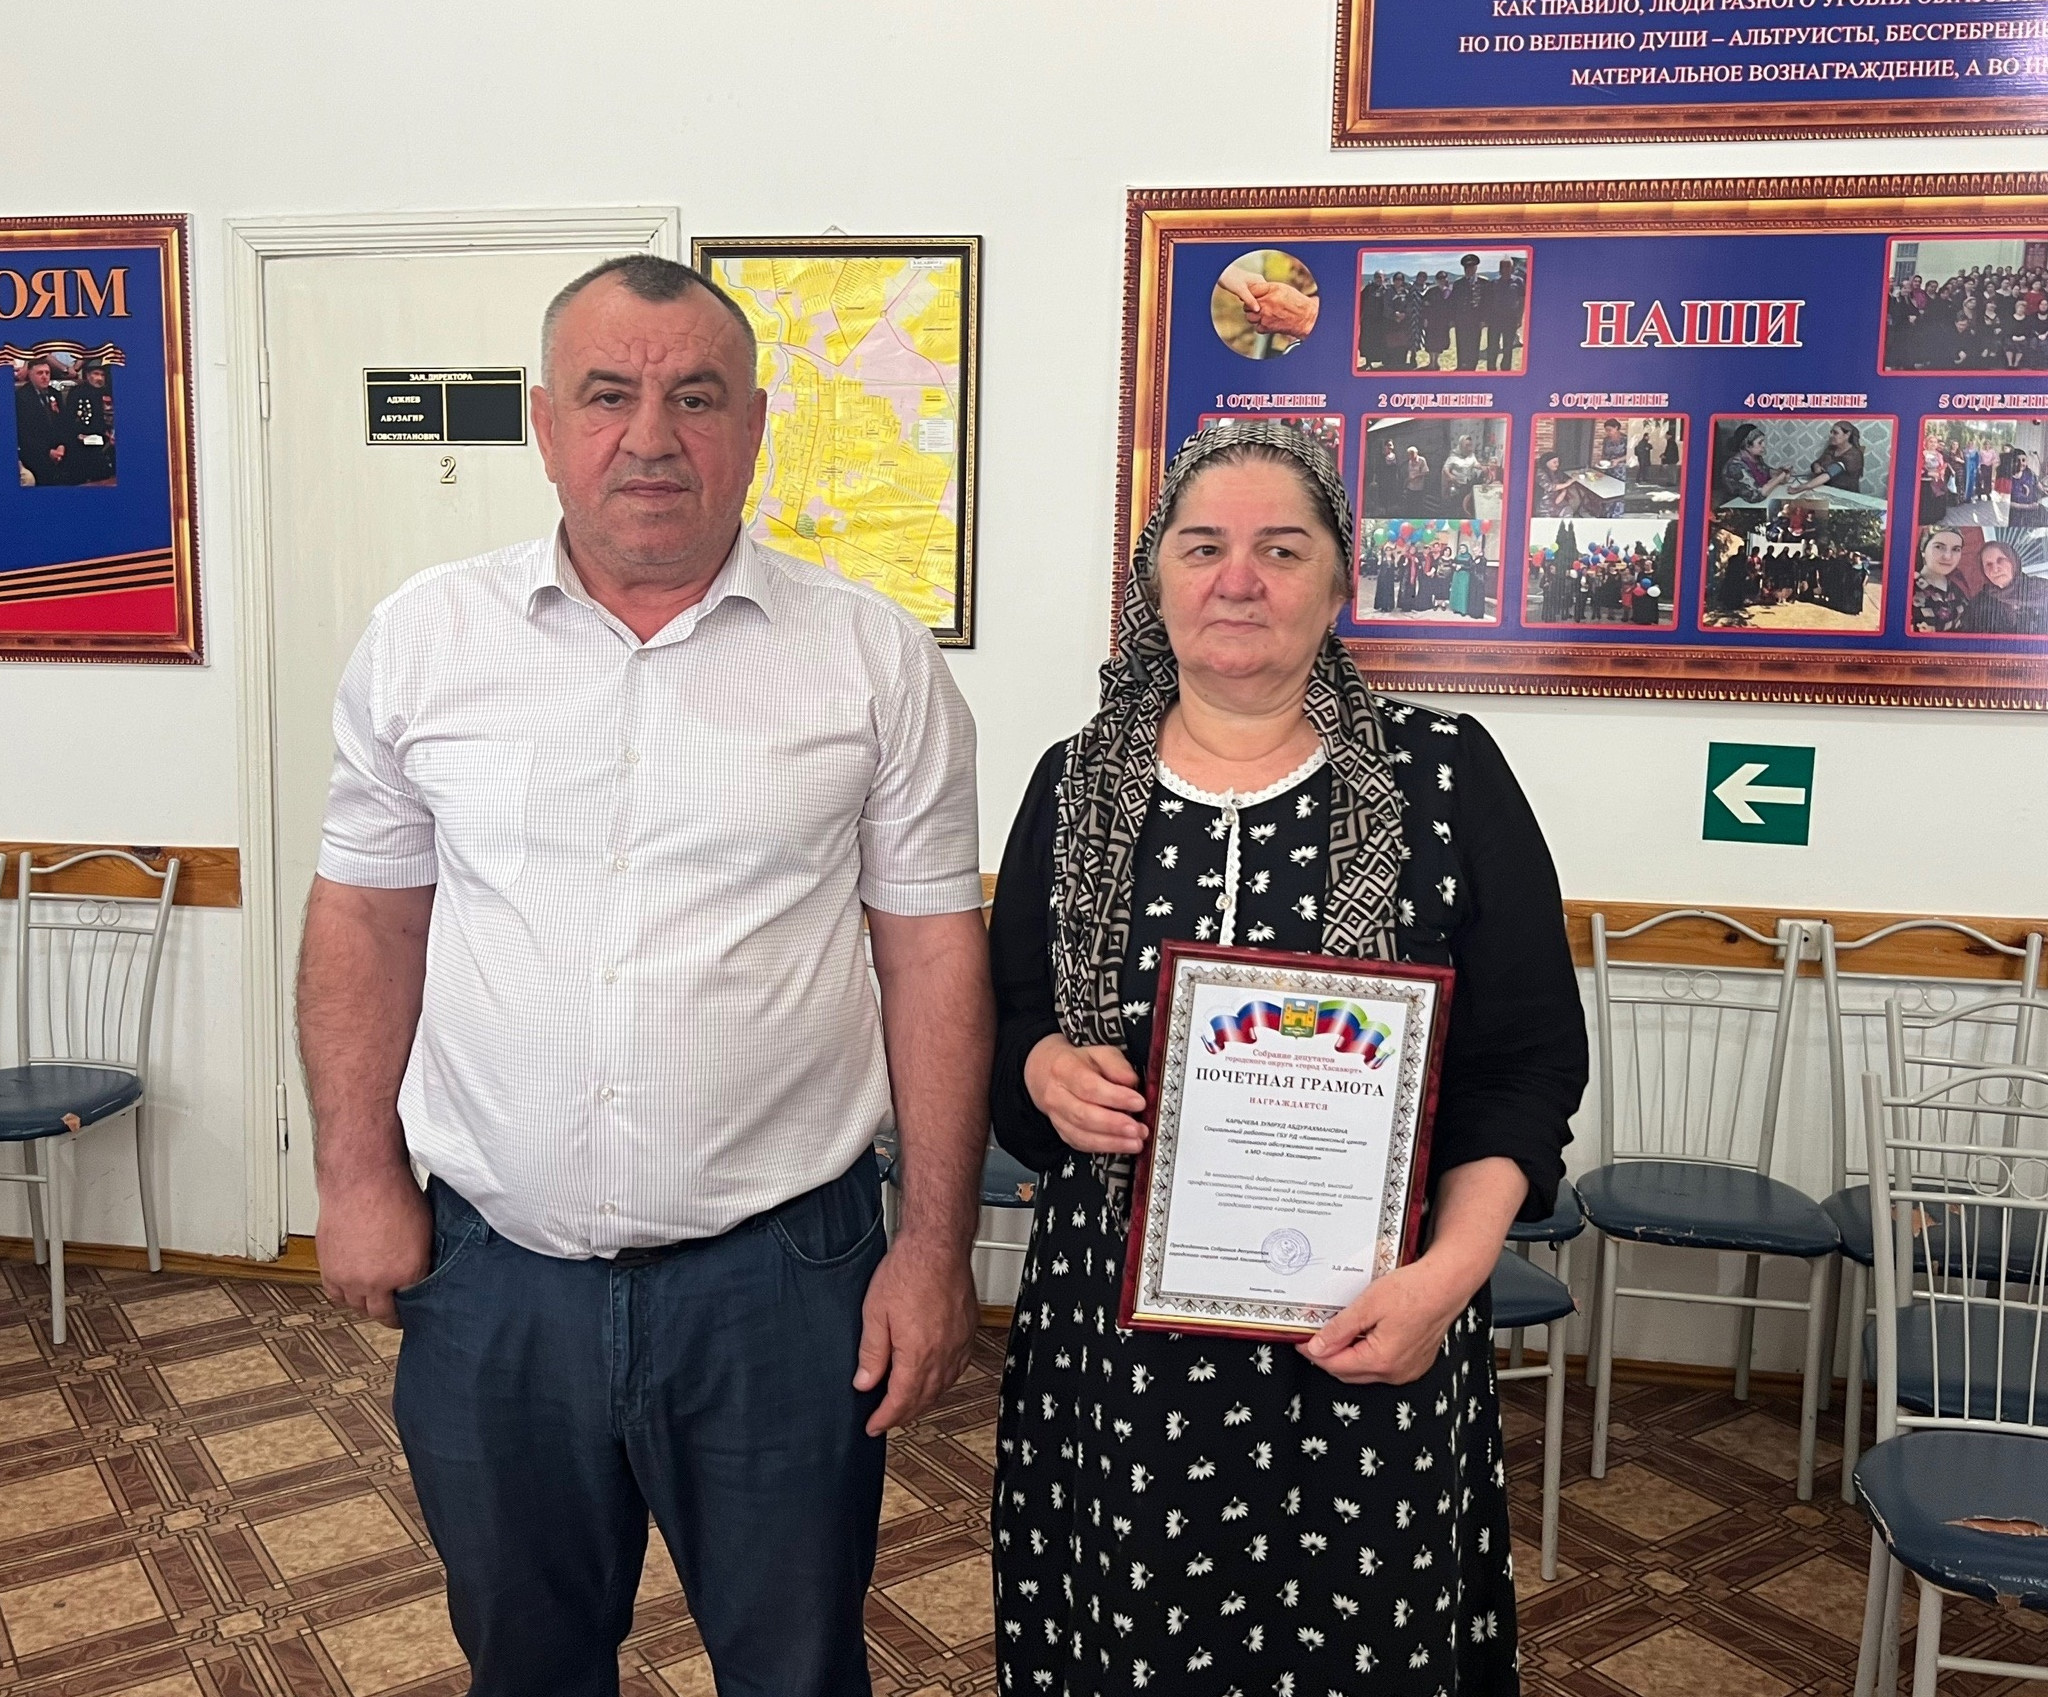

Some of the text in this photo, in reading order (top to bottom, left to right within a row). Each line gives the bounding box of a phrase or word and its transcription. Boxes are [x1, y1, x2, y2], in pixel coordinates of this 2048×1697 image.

[1492, 0, 1535, 17] КАК
[1540, 0, 1644, 16] ПРАВИЛО,
[1649, 0, 1716, 15] ЛЮДИ
[1459, 36, 1489, 52] НО
[1493, 35, 1525, 52] ПО
[1529, 32, 1636, 51] ВЕЛЕНИЮ
[1639, 30, 1709, 52] ДУШИ
[1728, 25, 1880, 47] АЛЬТРУИСТЫ,
[1571, 65, 1743, 86] МАТЕРИАЛЬНОЕ
[1748, 59, 1960, 82] ВОЗНАГРАЖДЕНИЕ,
[1964, 59, 1982, 76] А
[1986, 57, 2020, 76] ВО
[1580, 300, 1806, 348] НАШИ
[1215, 394, 1225, 408] 1
[1378, 394, 1388, 408] 2
[1549, 393, 1559, 407] 3
[1744, 393, 1755, 408] 4
[1938, 393, 1950, 408] 5
[440, 456, 457, 484] 2
[1252, 1048, 1334, 1064] Собрание депутатов
[1195, 1067, 1385, 1097] ПОЧЕТНАЯ ГРАМОТА
[1248, 1097, 1328, 1111] НАГРАЖДАЕТСЯ
